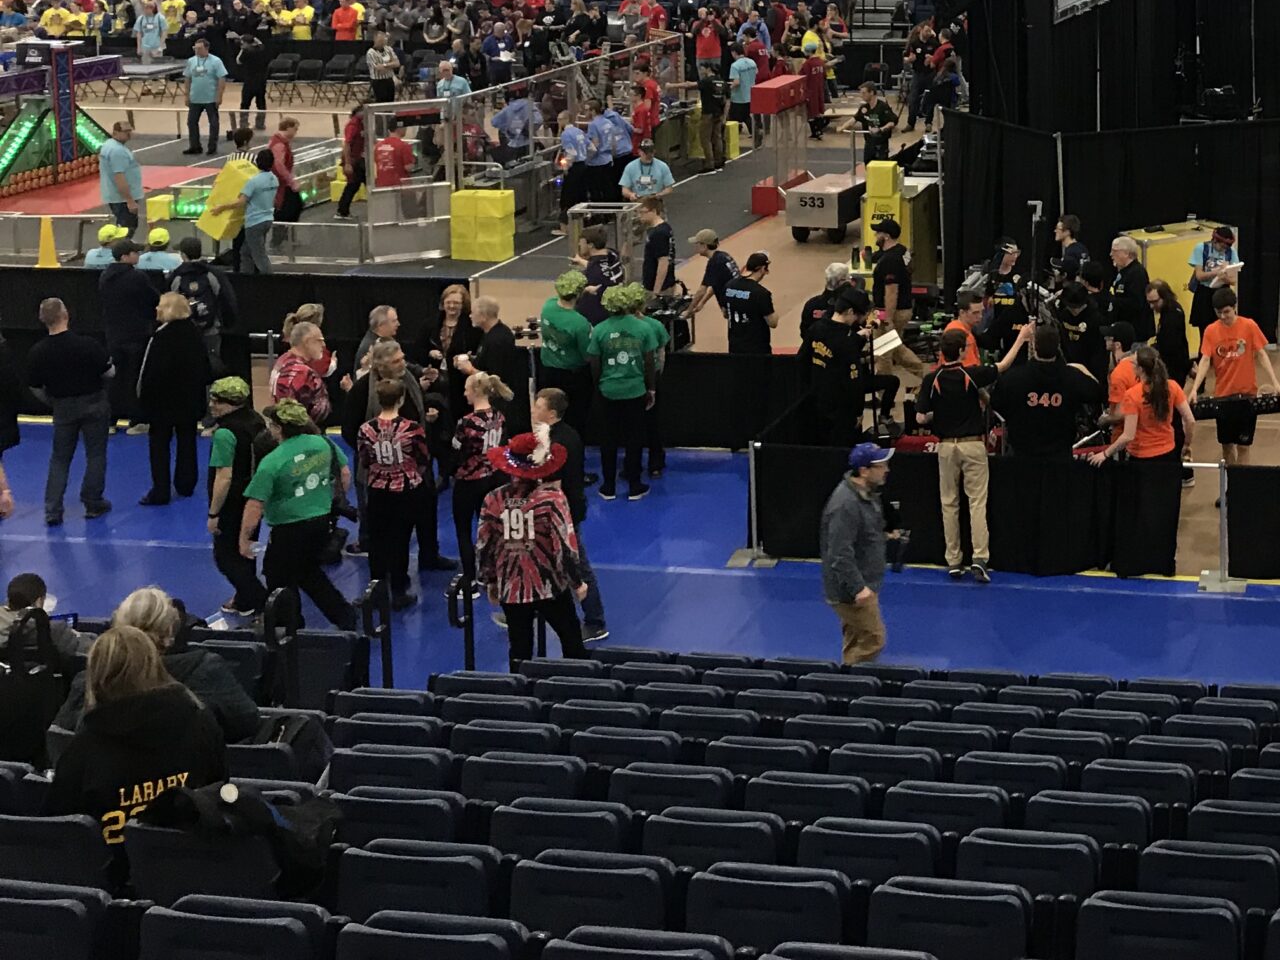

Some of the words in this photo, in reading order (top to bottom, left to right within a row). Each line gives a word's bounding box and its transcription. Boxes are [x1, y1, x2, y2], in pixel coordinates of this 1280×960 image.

[800, 196, 825, 208] 533
[1027, 392, 1062, 407] 340
[374, 441, 403, 464] 191
[501, 509, 536, 540] 191
[102, 805, 148, 845] 2
